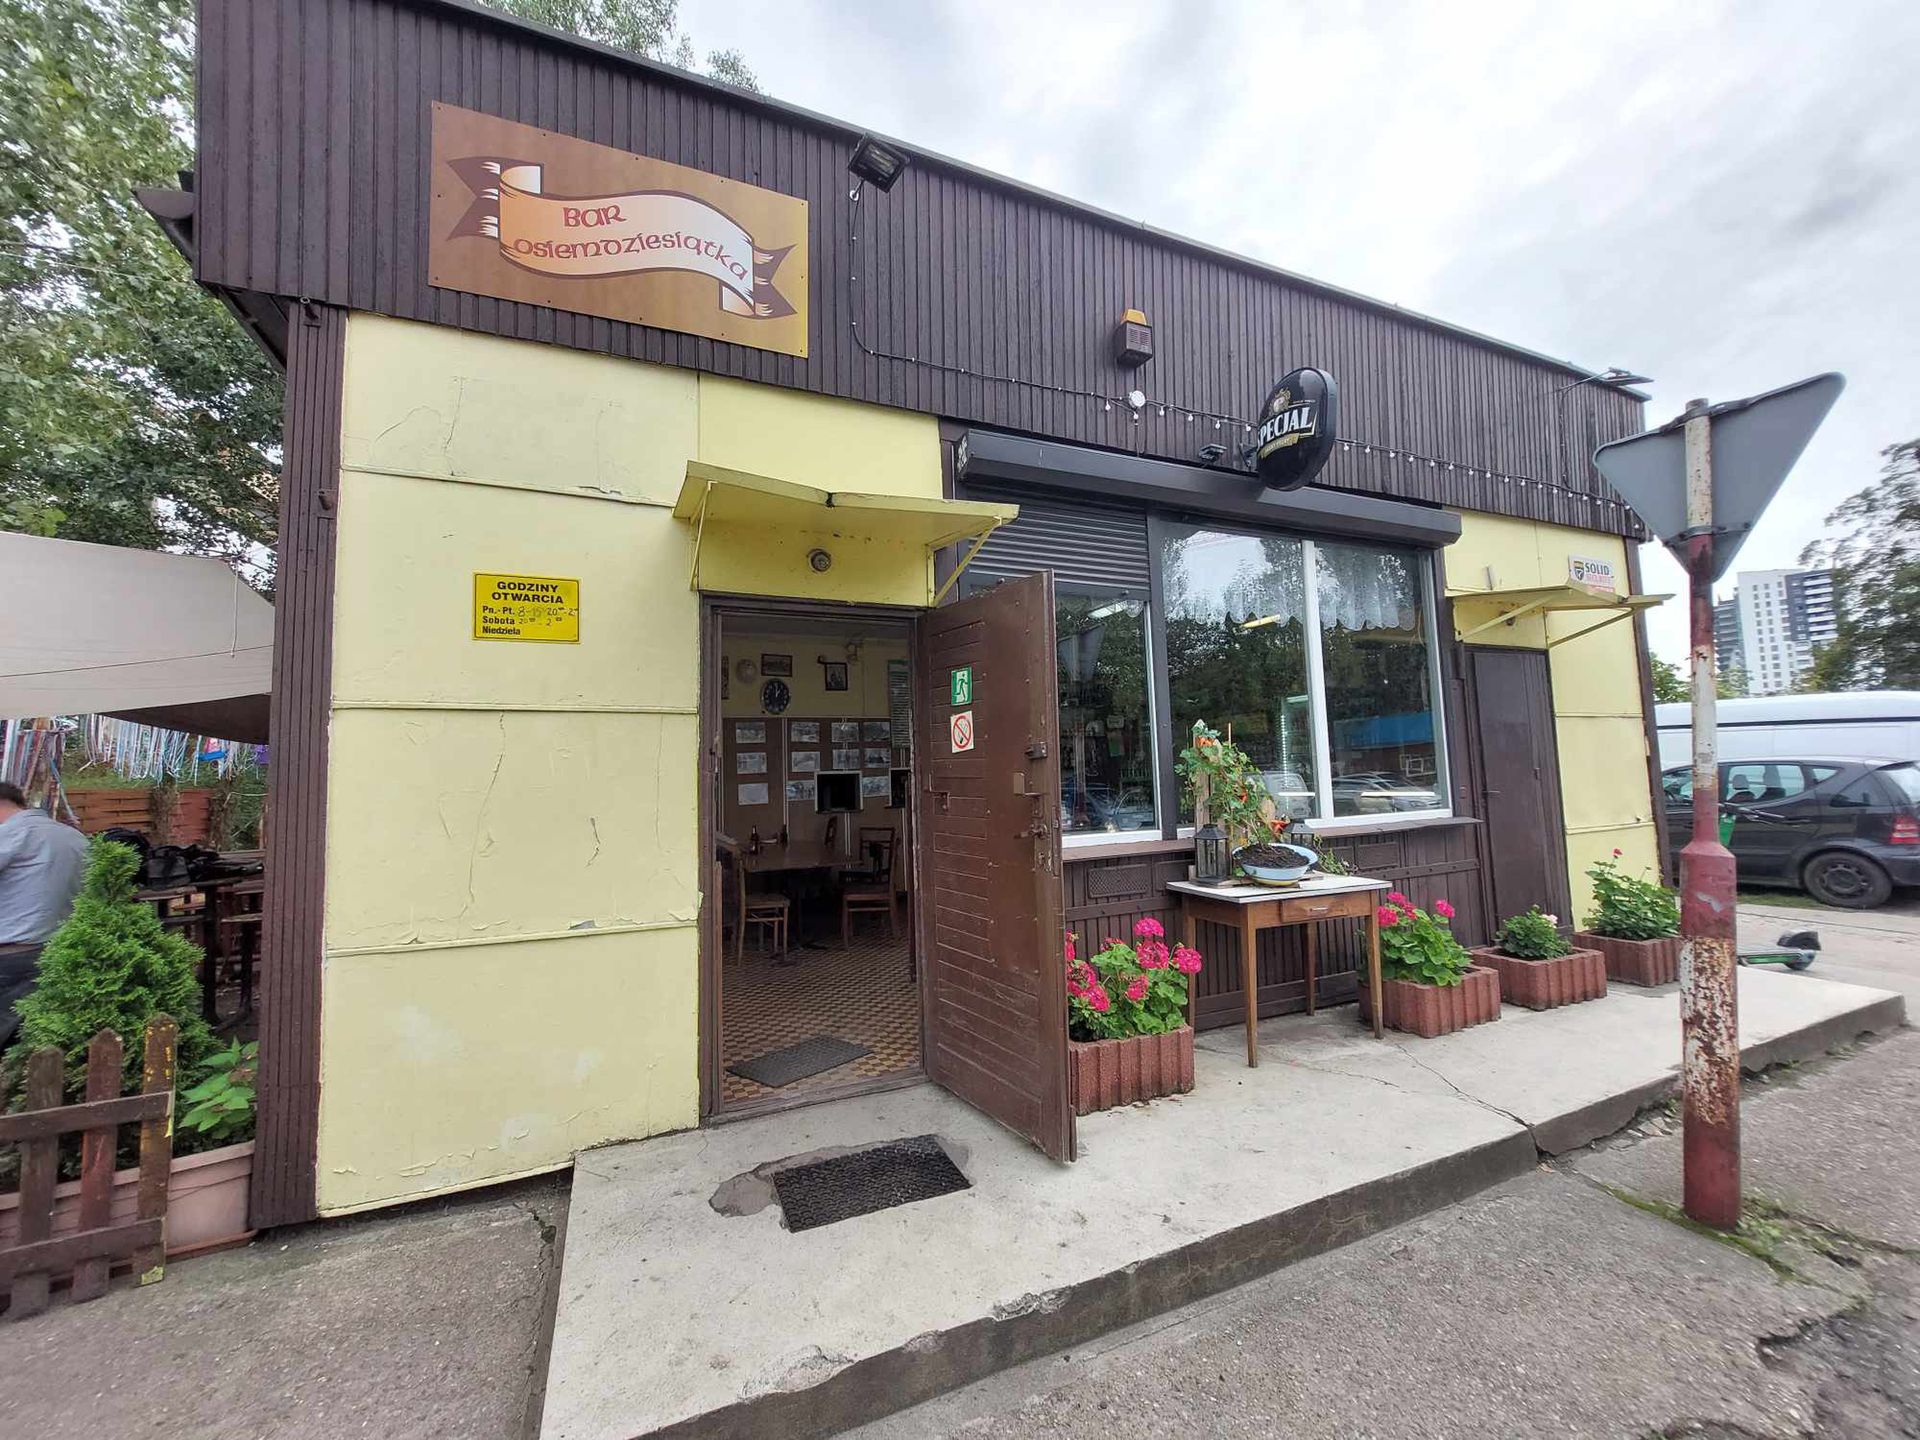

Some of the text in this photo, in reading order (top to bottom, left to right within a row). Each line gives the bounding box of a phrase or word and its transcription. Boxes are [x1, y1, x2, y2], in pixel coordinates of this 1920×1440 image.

[1585, 562, 1610, 575] SOLID
[497, 581, 558, 592] GODZINY
[492, 592, 563, 603] OTWARCIA
[482, 616, 515, 625] Sobota
[482, 625, 521, 635] Niedziela
